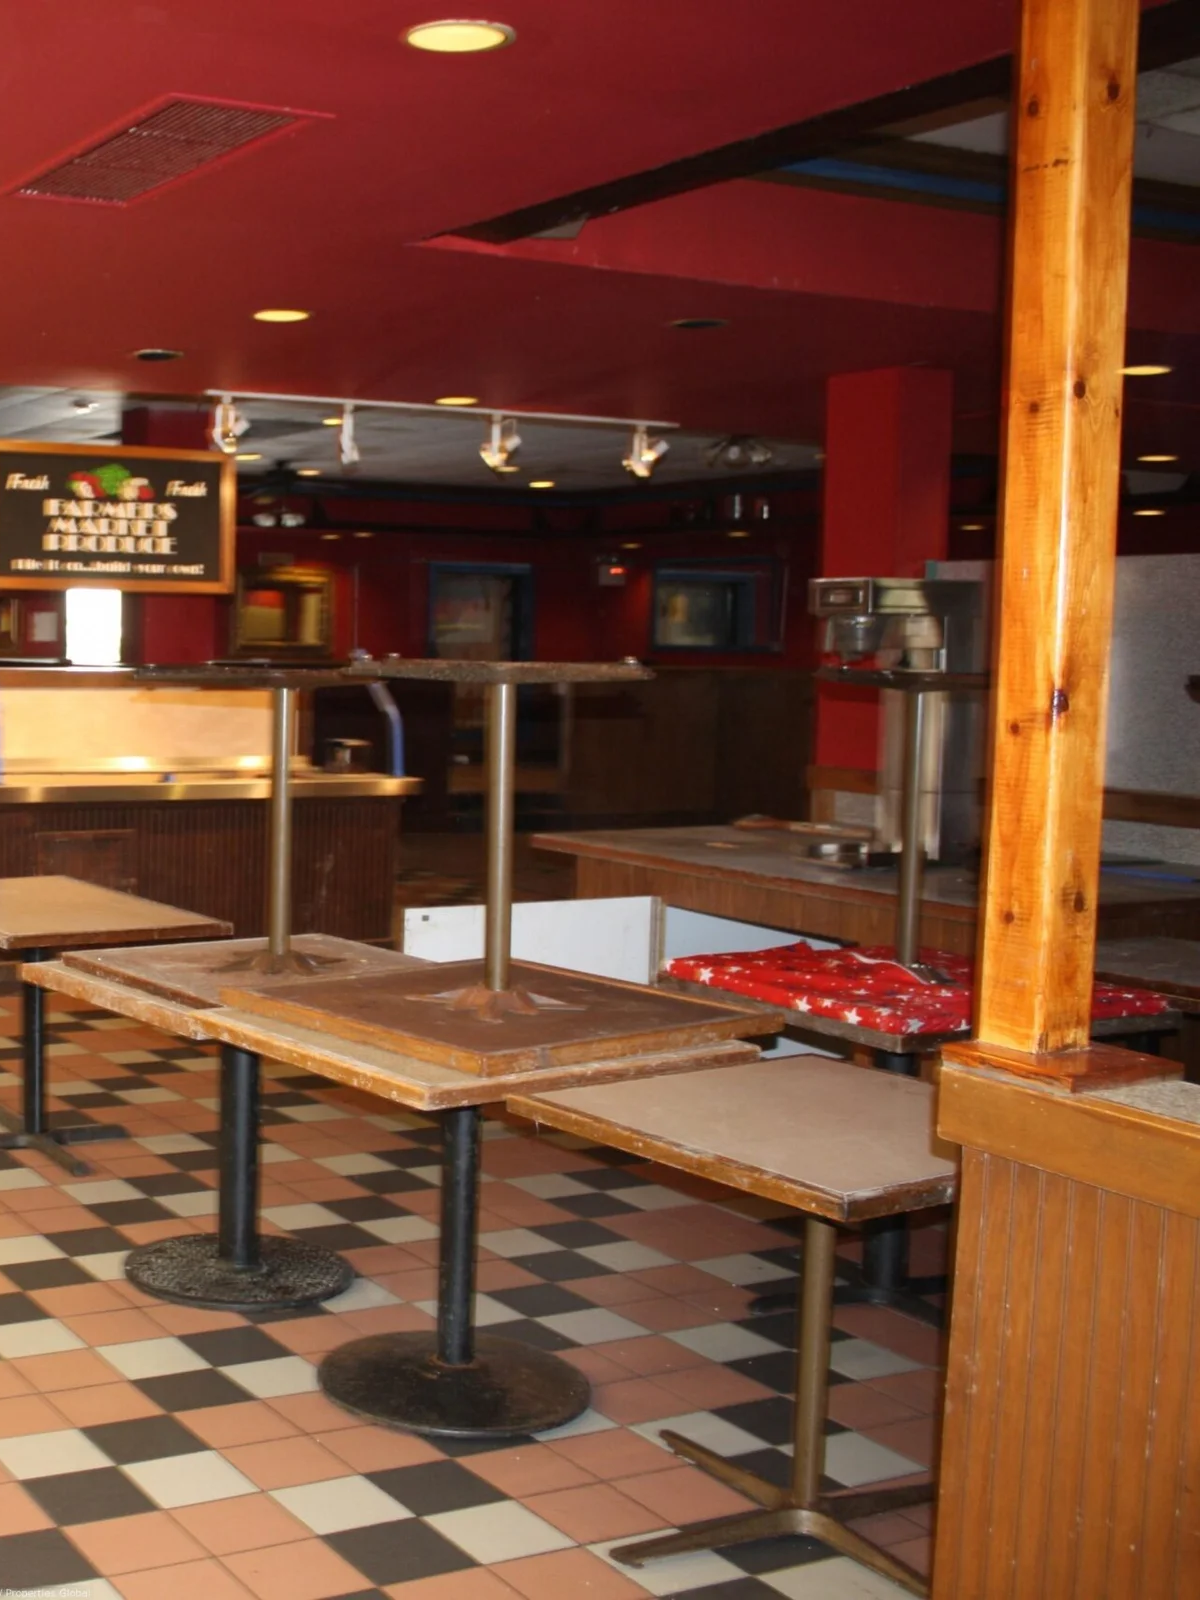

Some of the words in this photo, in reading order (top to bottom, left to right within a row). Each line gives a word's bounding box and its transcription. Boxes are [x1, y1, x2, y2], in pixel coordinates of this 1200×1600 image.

[42, 498, 178, 520] FARMERS
[47, 517, 170, 537] MARKET
[42, 534, 178, 555] PRODUCE
